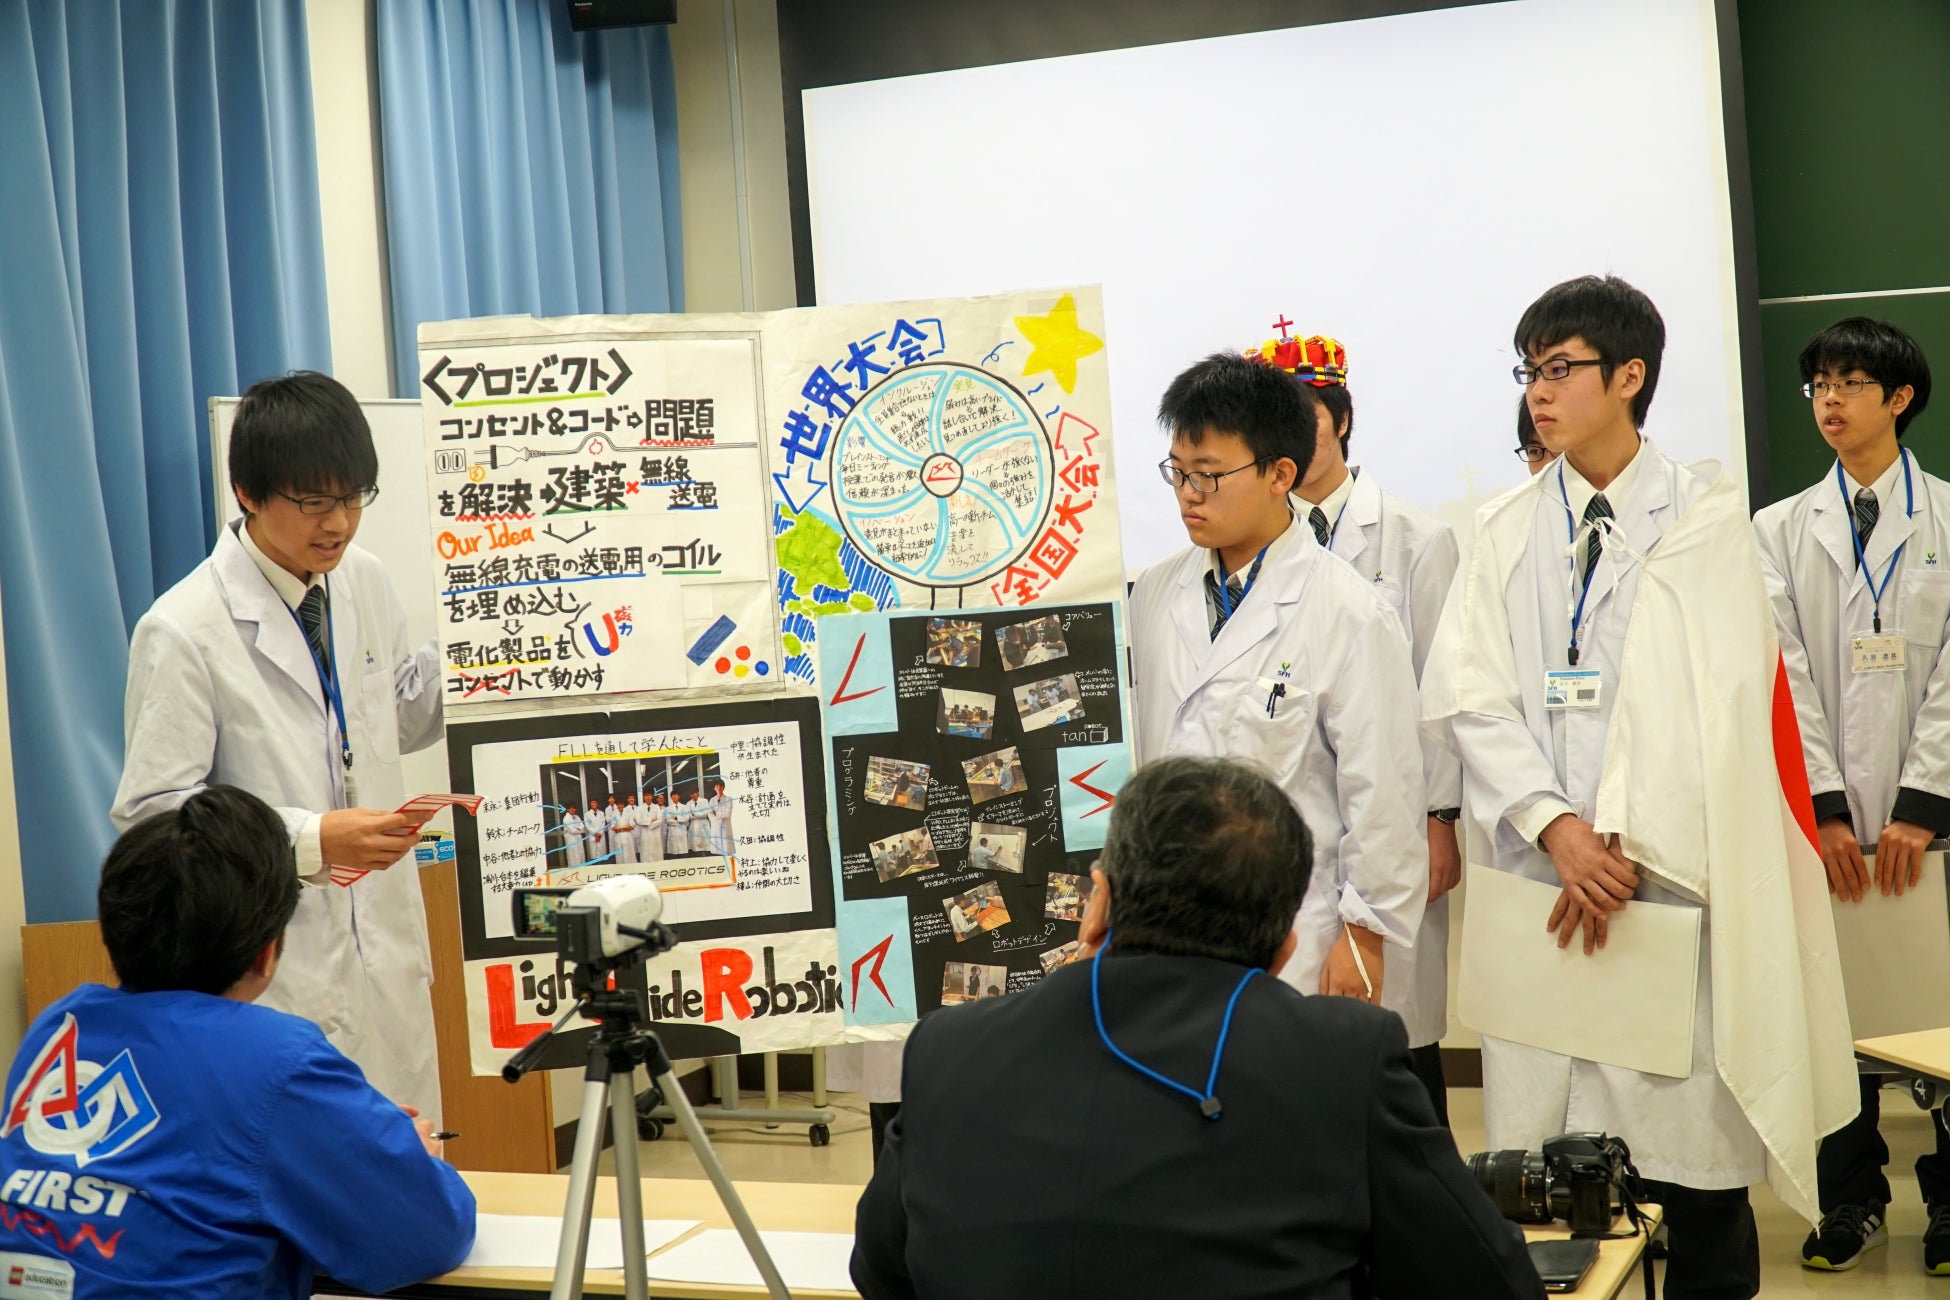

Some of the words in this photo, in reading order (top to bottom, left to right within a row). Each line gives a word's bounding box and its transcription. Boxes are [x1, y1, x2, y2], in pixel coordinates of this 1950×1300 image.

[780, 318, 929, 460] 世界大会
[644, 398, 714, 441] 問題
[639, 456, 691, 483] 無線
[438, 479, 533, 517] を解決
[544, 461, 626, 510] 建築
[669, 482, 717, 507] 送電
[437, 531, 481, 559] Our
[486, 523, 535, 549] Idea
[1003, 454, 1102, 606] 全国大会
[444, 538, 722, 590] 無線充電の送電用のコイル
[444, 587, 580, 623] を埋め込む
[1064, 611, 1102, 621] コアバリュー
[447, 635, 572, 667] 電化製品を
[447, 665, 605, 694] コンセントで動かす
[841, 746, 857, 817] プログラミング
[1043, 784, 1059, 842] プロジェクト
[660, 865, 726, 879] ROBOTICS
[993, 934, 1048, 949] ロボットデザイン
[0, 1168, 137, 1216] FIRST
